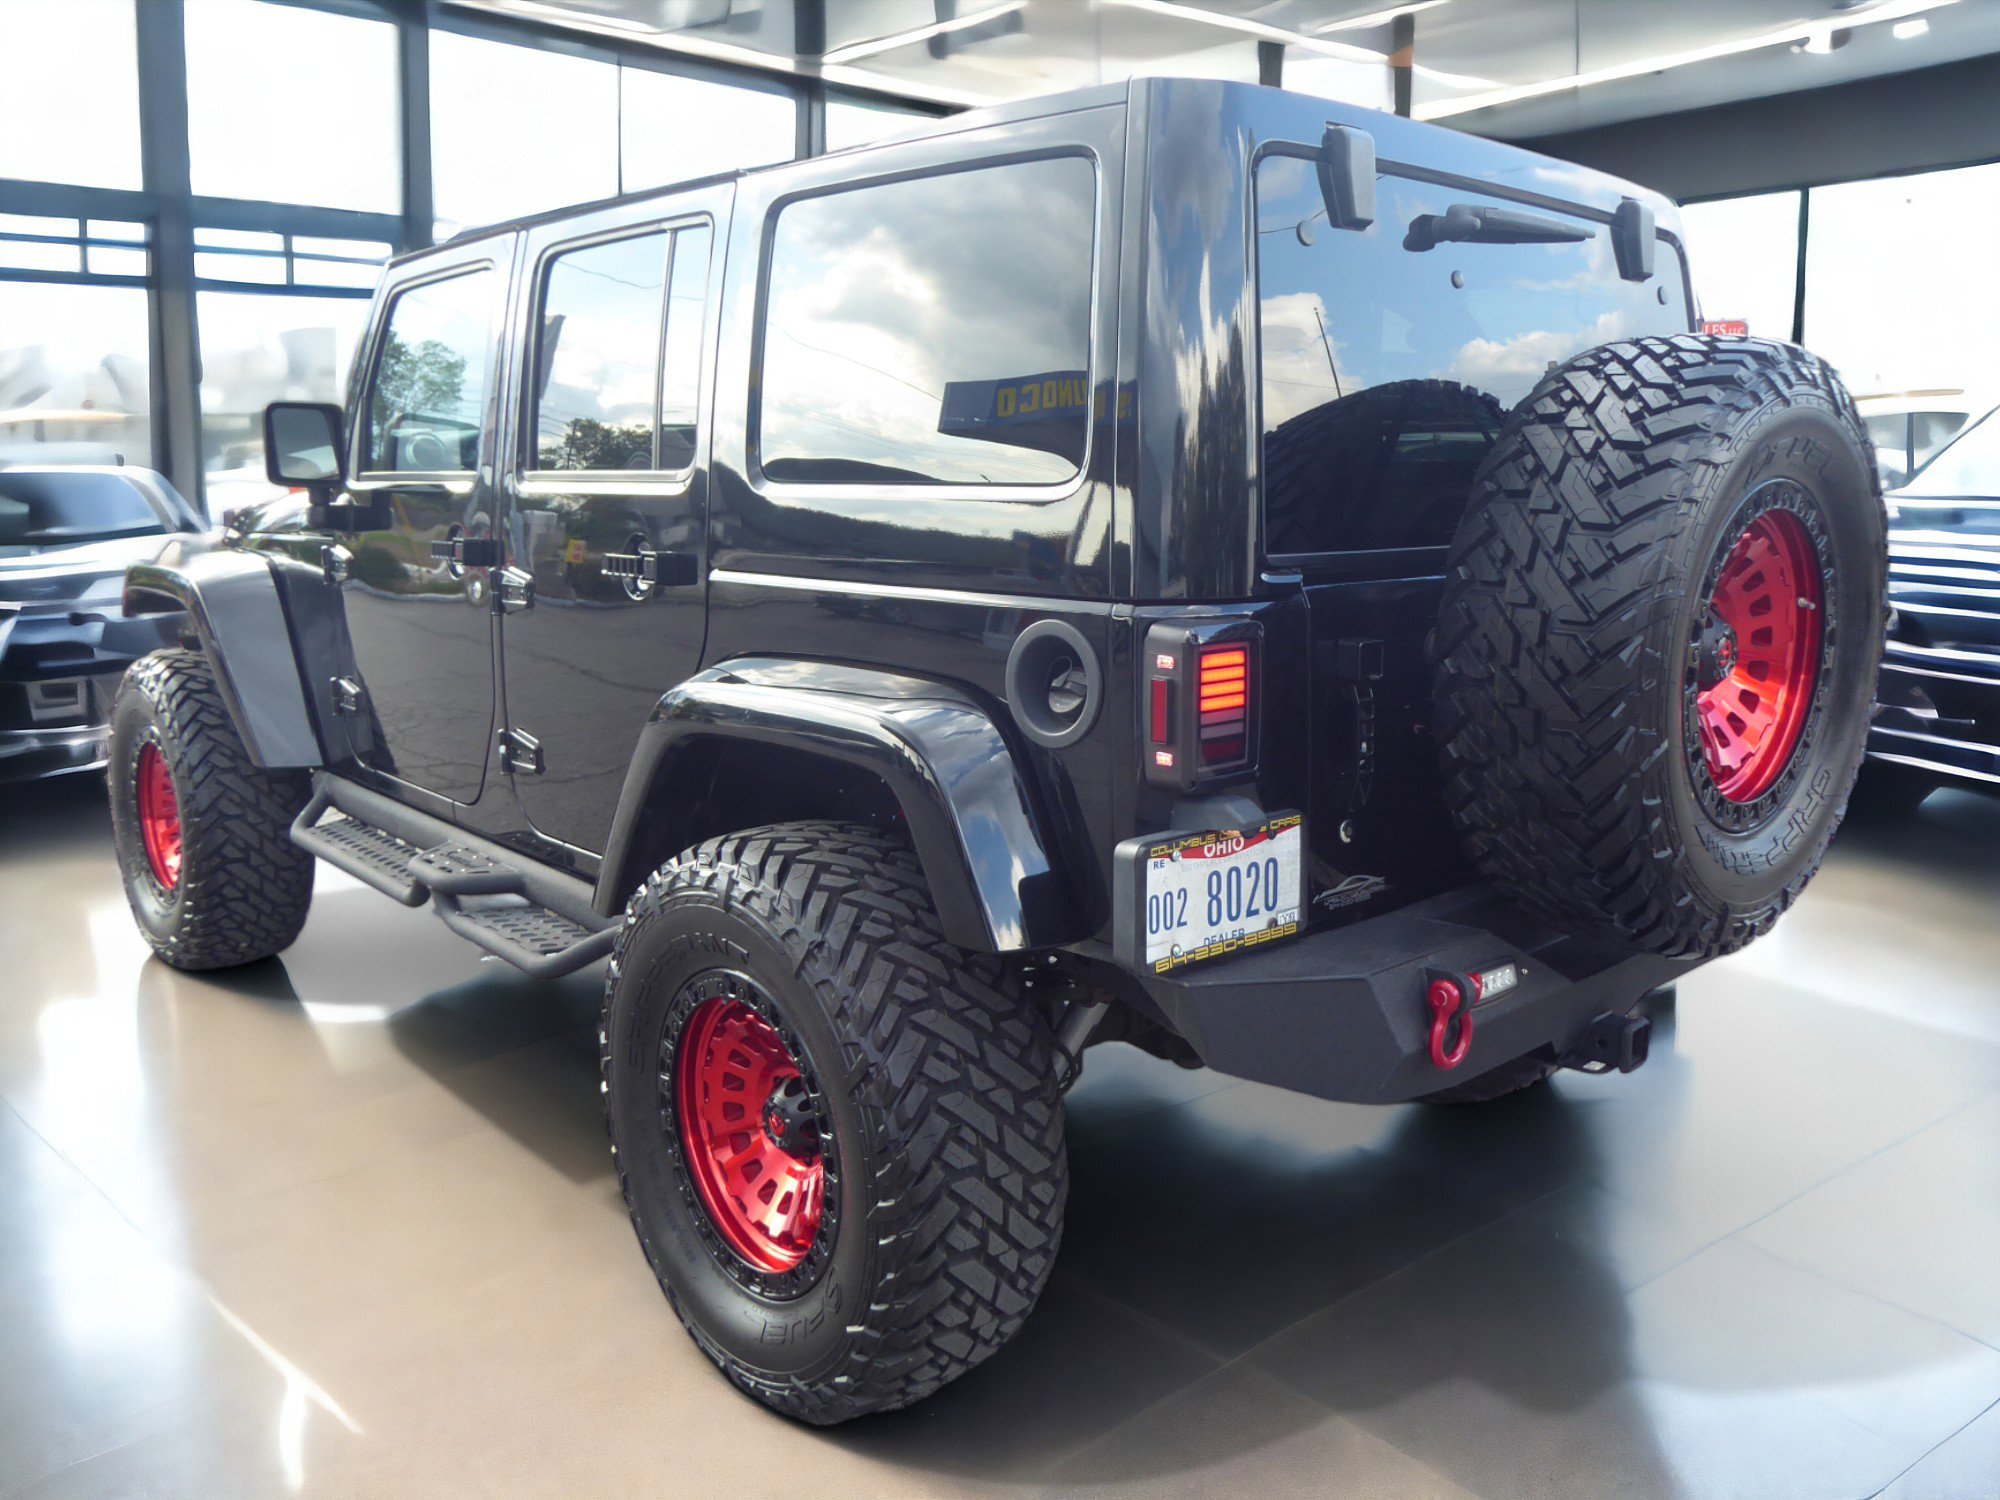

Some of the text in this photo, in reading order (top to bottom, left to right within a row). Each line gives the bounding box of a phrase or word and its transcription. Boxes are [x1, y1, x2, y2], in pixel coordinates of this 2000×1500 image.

[1151, 834, 1216, 858] COLUMBUS
[1269, 815, 1301, 830] CARS
[1204, 836, 1245, 858] OHIO
[1149, 887, 1188, 935] 002
[1207, 857, 1278, 927] 8020
[1155, 922, 1298, 973] 614-230-9999
[1203, 928, 1245, 946] DEALER
